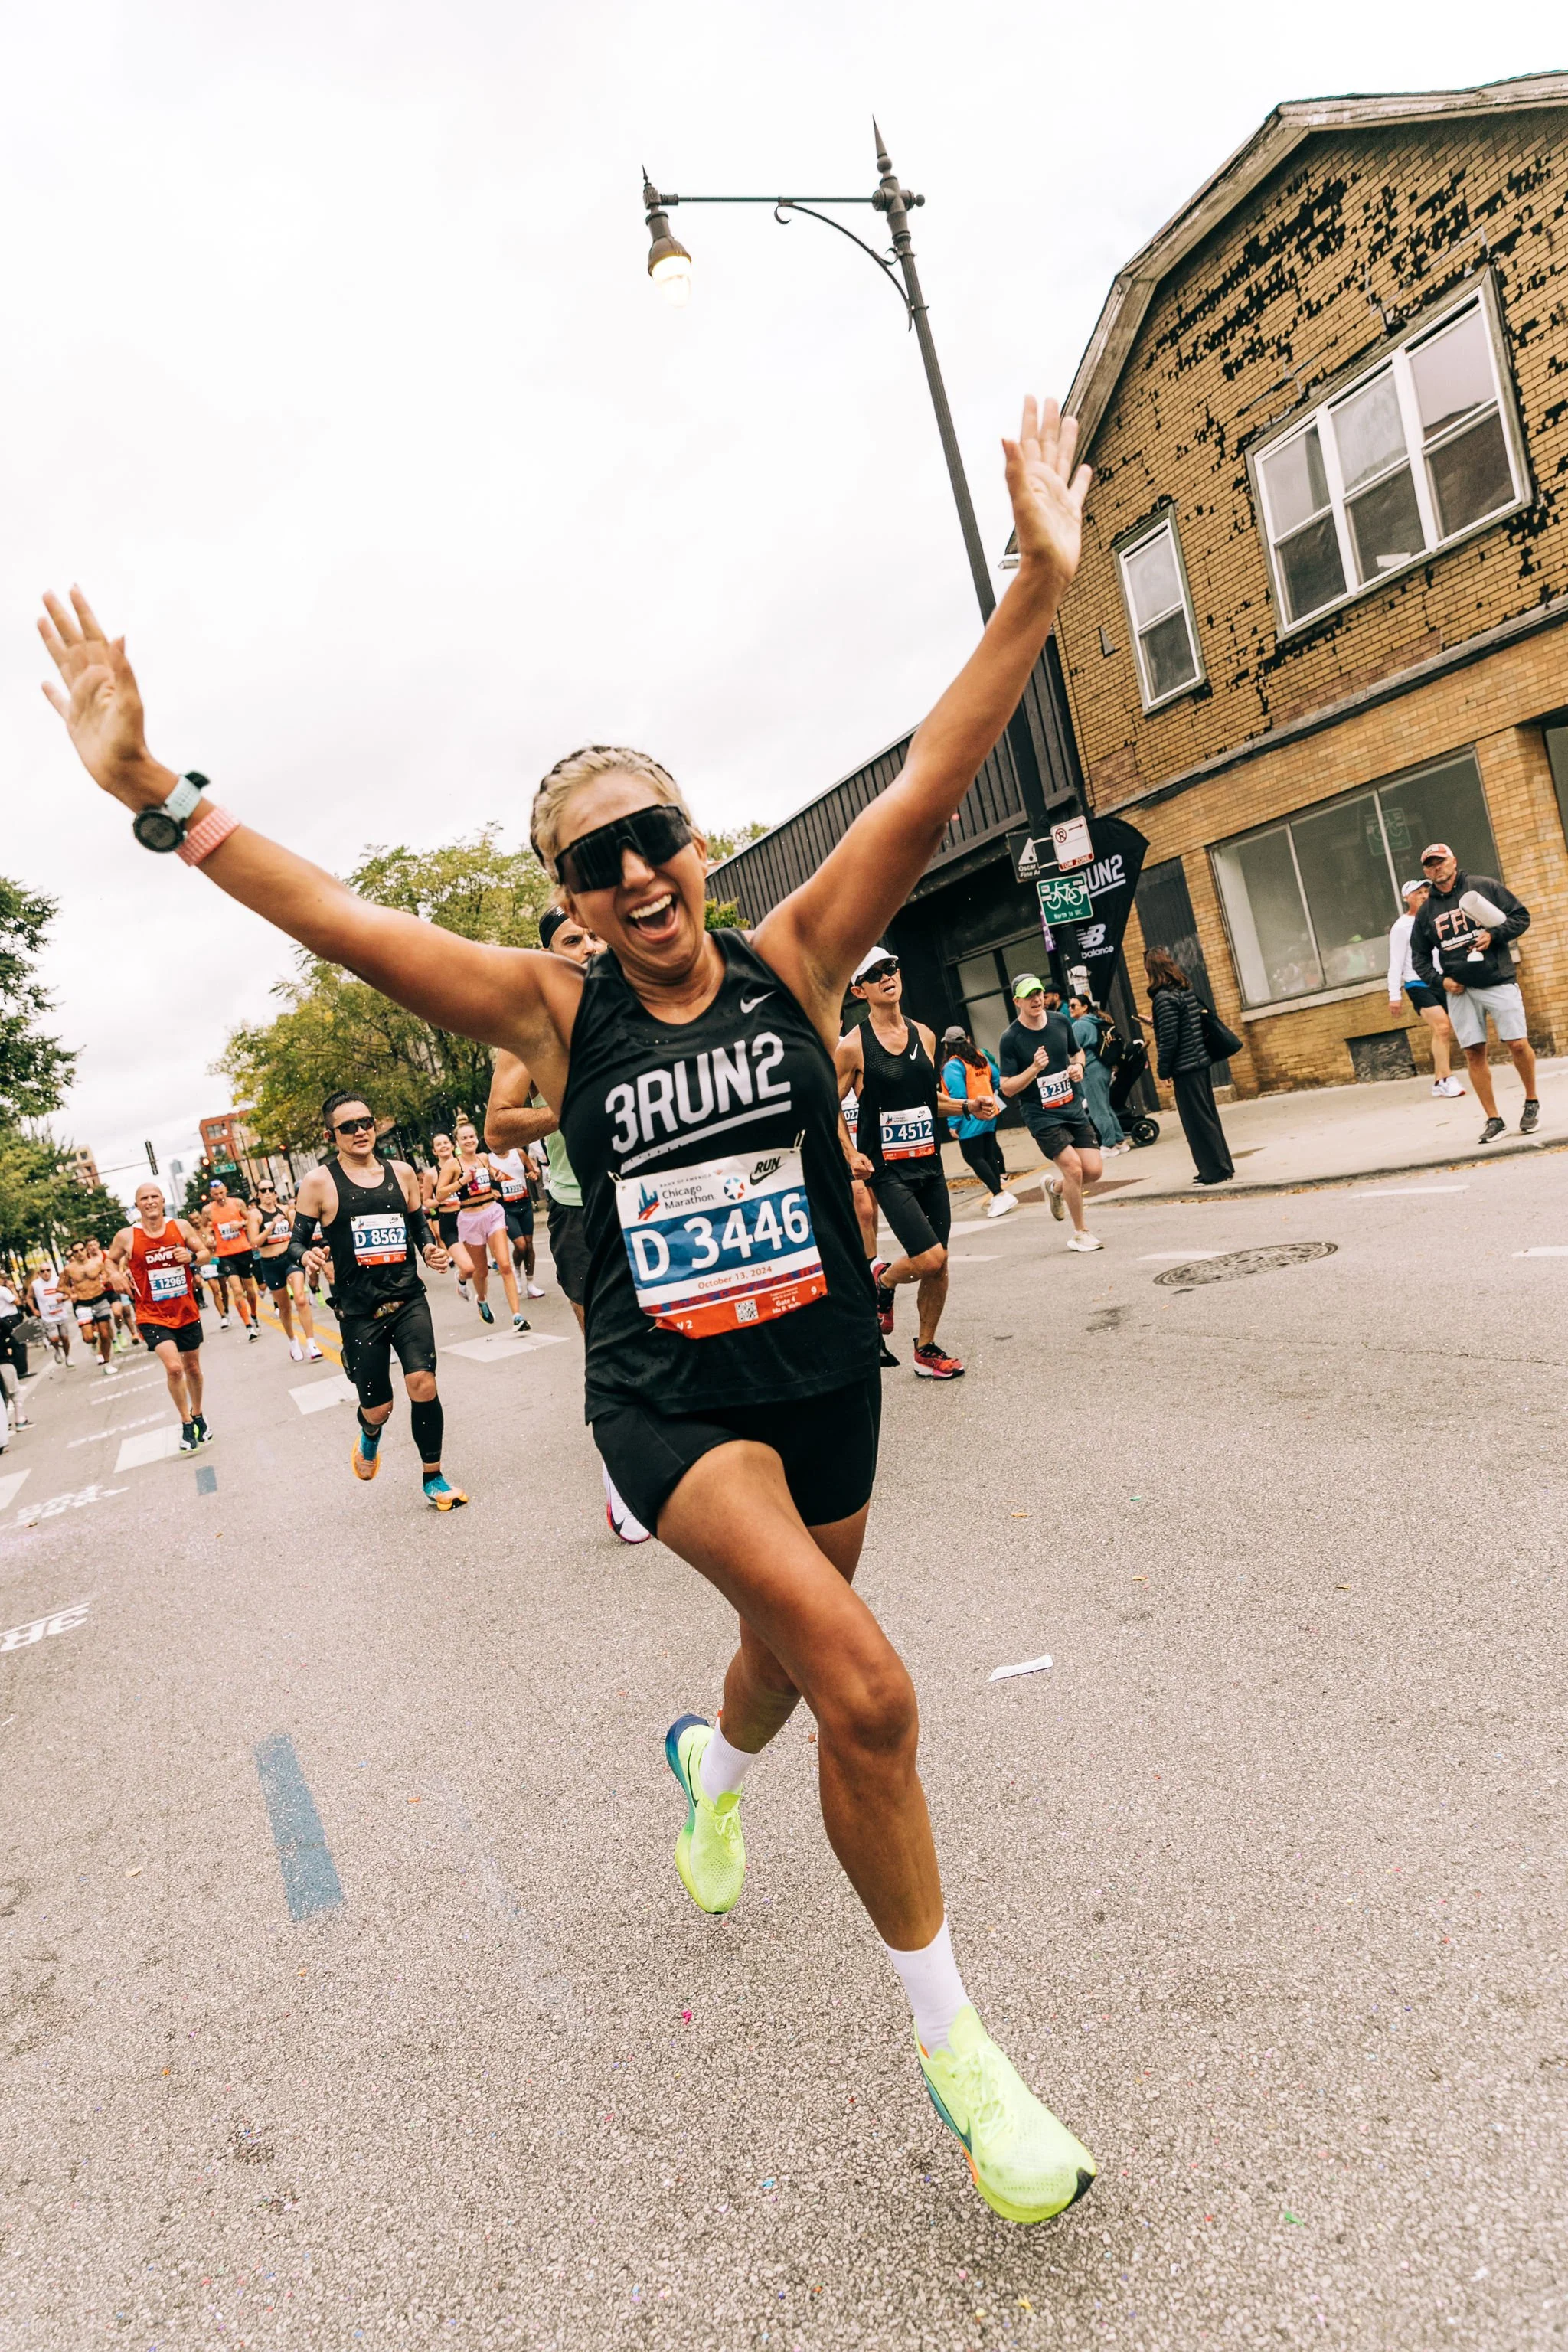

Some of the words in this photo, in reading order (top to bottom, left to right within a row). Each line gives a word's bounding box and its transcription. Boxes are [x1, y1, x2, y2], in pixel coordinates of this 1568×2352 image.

[1081, 946, 1114, 959] balance
[605, 1031, 791, 1154] 3RUN2
[1040, 1087, 1049, 1098] B
[1050, 1079, 1071, 1096] 2316
[882, 1126, 893, 1142] D
[898, 1120, 933, 1140] 4512
[753, 1157, 782, 1175] RUN
[662, 1184, 703, 1199] Chicago
[665, 1193, 714, 1210] Marathon
[354, 1231, 367, 1248] D
[371, 1227, 407, 1246] 8562
[630, 1229, 670, 1282] D
[684, 1192, 810, 1269] 3446
[145, 1250, 173, 1264] DAVE
[149, 1280, 158, 1290] E
[158, 1275, 186, 1289] 12969
[697, 1275, 732, 1289] October
[735, 1272, 750, 1282] 13,
[750, 1266, 773, 1278] 2024
[810, 1286, 817, 1295] 9
[776, 1298, 790, 1307] Gate
[685, 1319, 694, 1330] 2
